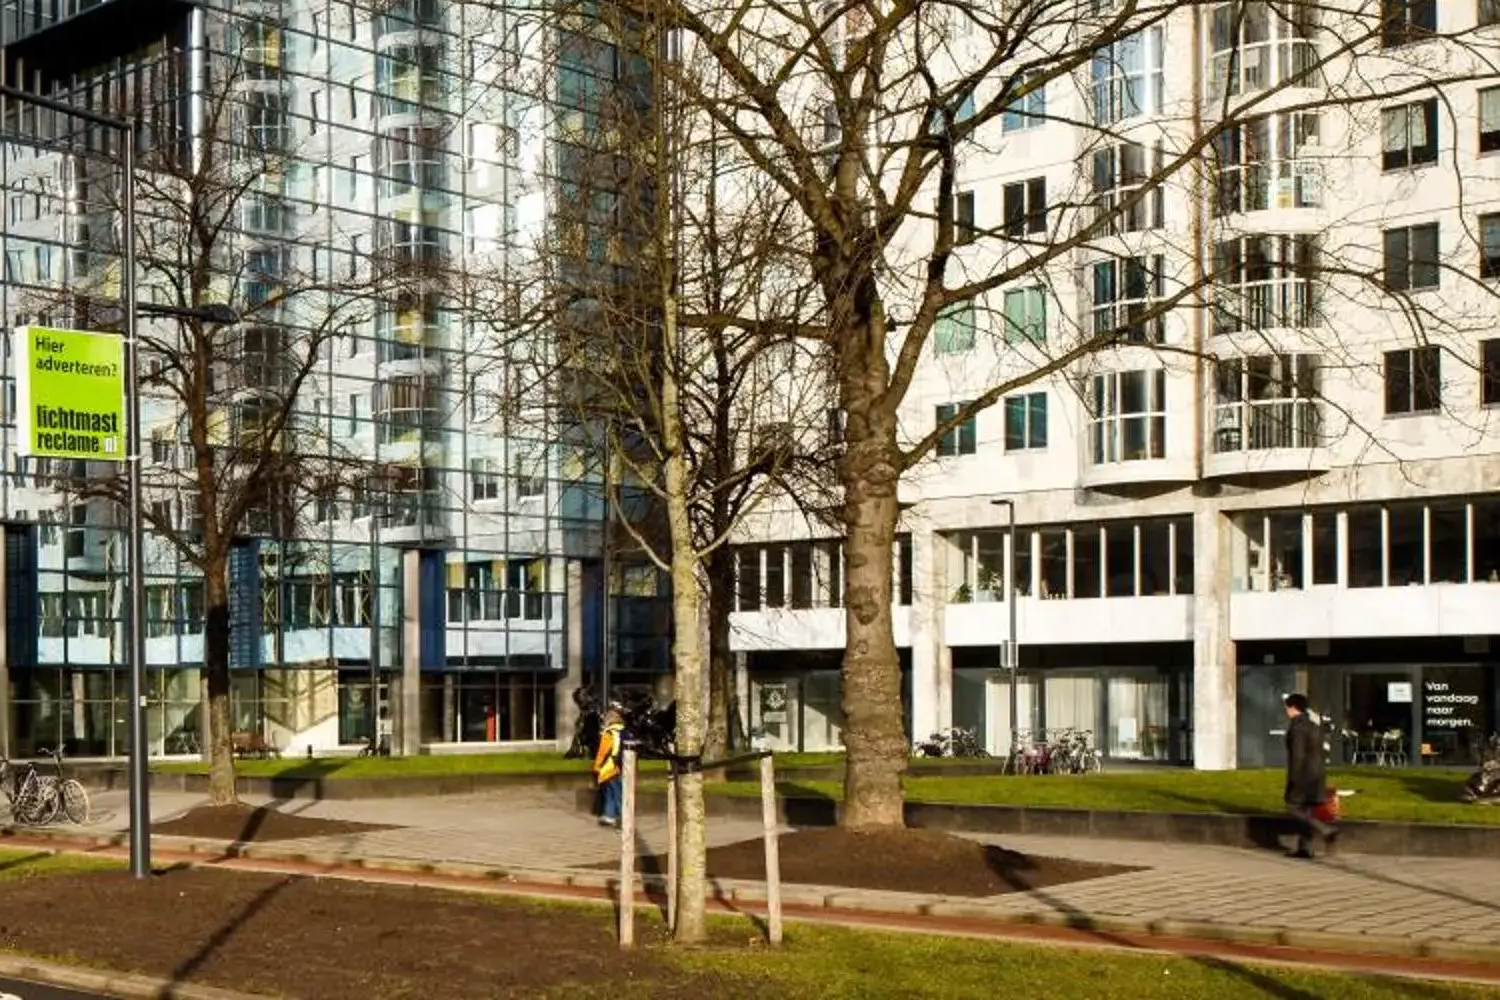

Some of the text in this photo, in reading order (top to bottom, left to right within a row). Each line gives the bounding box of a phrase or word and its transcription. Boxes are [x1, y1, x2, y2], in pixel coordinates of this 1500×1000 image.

[35, 336, 65, 353] Hier
[36, 356, 117, 376] adverteren?
[36, 405, 118, 433] lichtmast
[1426, 682, 1449, 691] Van
[1426, 693, 1478, 704] vandaag
[1426, 706, 1455, 715] naar
[1426, 718, 1475, 728] morgen.
